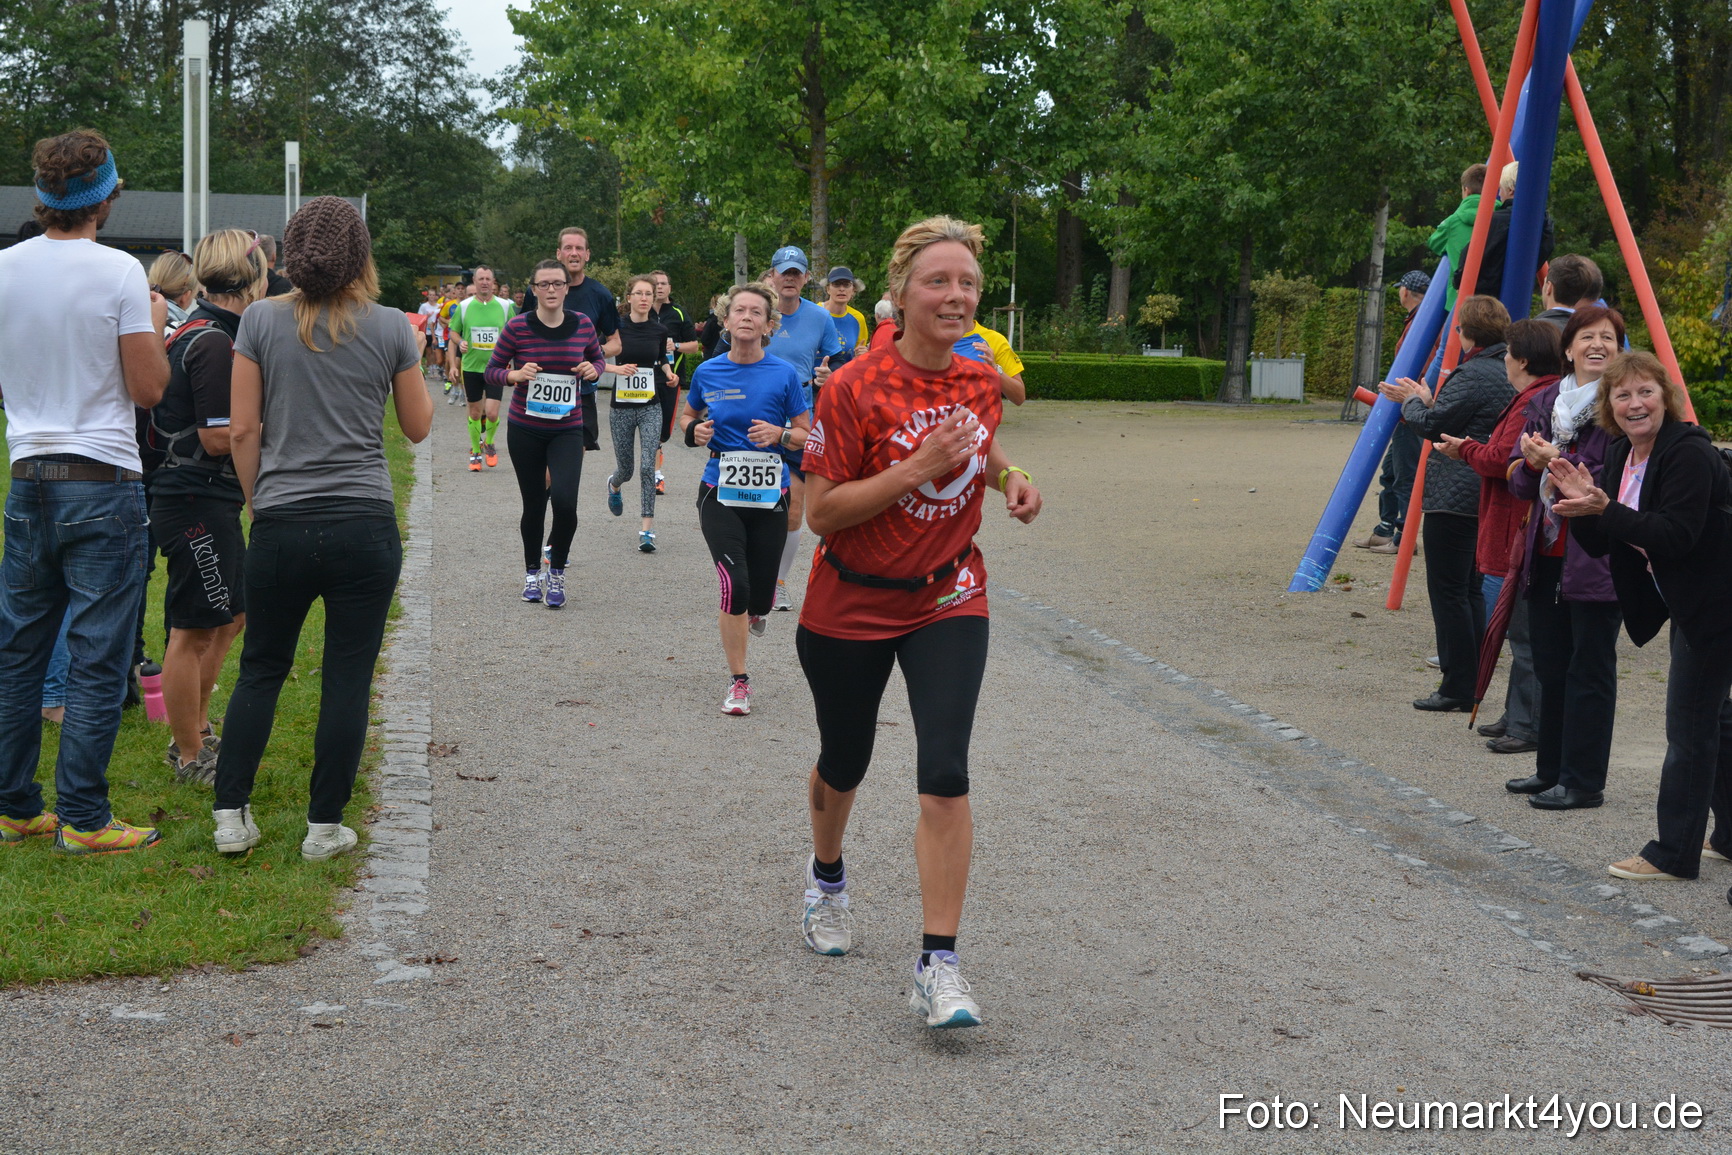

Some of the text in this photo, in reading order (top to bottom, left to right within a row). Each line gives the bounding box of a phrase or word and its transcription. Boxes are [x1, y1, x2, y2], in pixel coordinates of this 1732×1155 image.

[477, 332, 494, 343] 195
[625, 376, 648, 389] 108
[532, 383, 572, 403] 2900
[25, 463, 69, 479] PMA
[725, 464, 776, 487] 2355
[737, 491, 762, 502] Helga
[897, 492, 938, 521] ELAY
